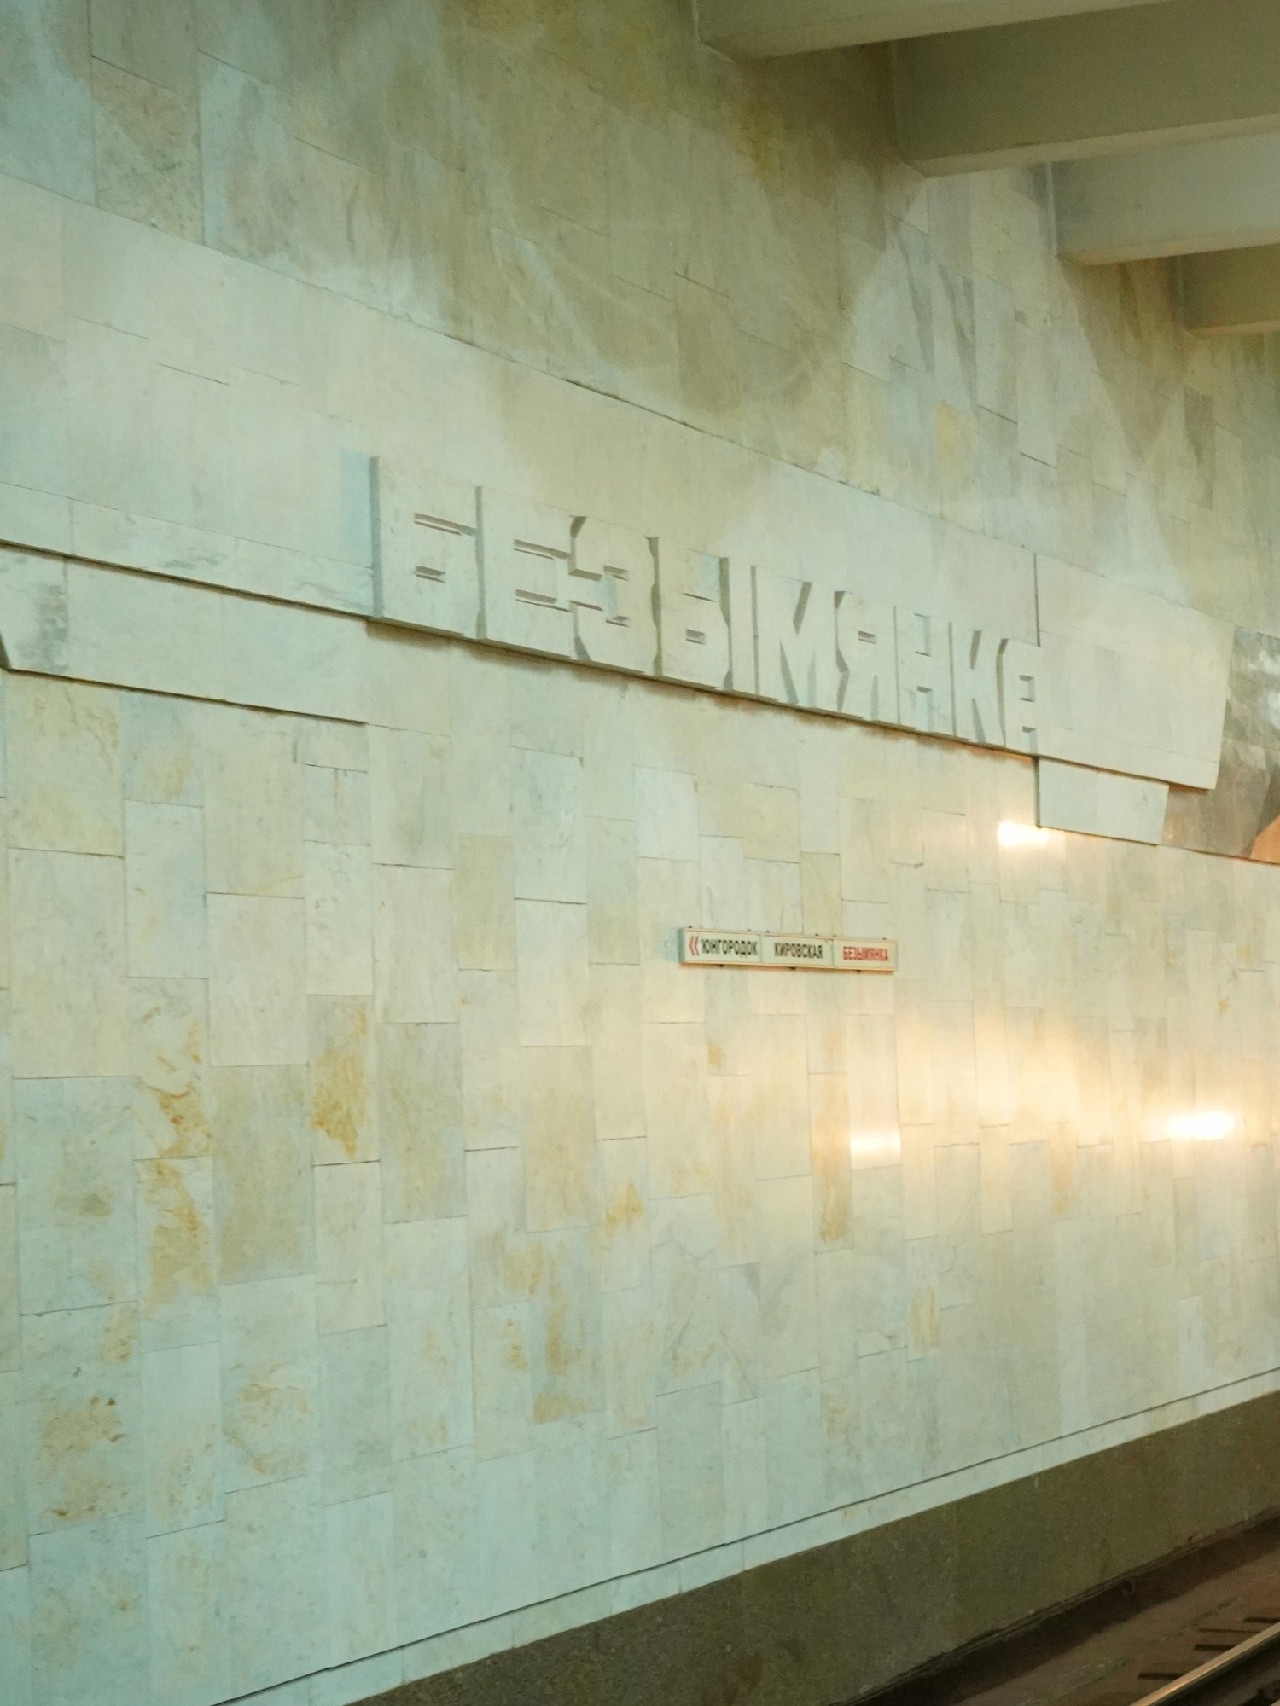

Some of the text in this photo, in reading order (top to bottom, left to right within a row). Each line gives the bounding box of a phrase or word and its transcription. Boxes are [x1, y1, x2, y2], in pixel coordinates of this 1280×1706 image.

[368, 455, 1048, 756] БЕЗЫМЯНКА
[701, 938, 889, 961] ЮНГОРОДОК КИРОВСКАЯ БЕЗЫМЯНКА
